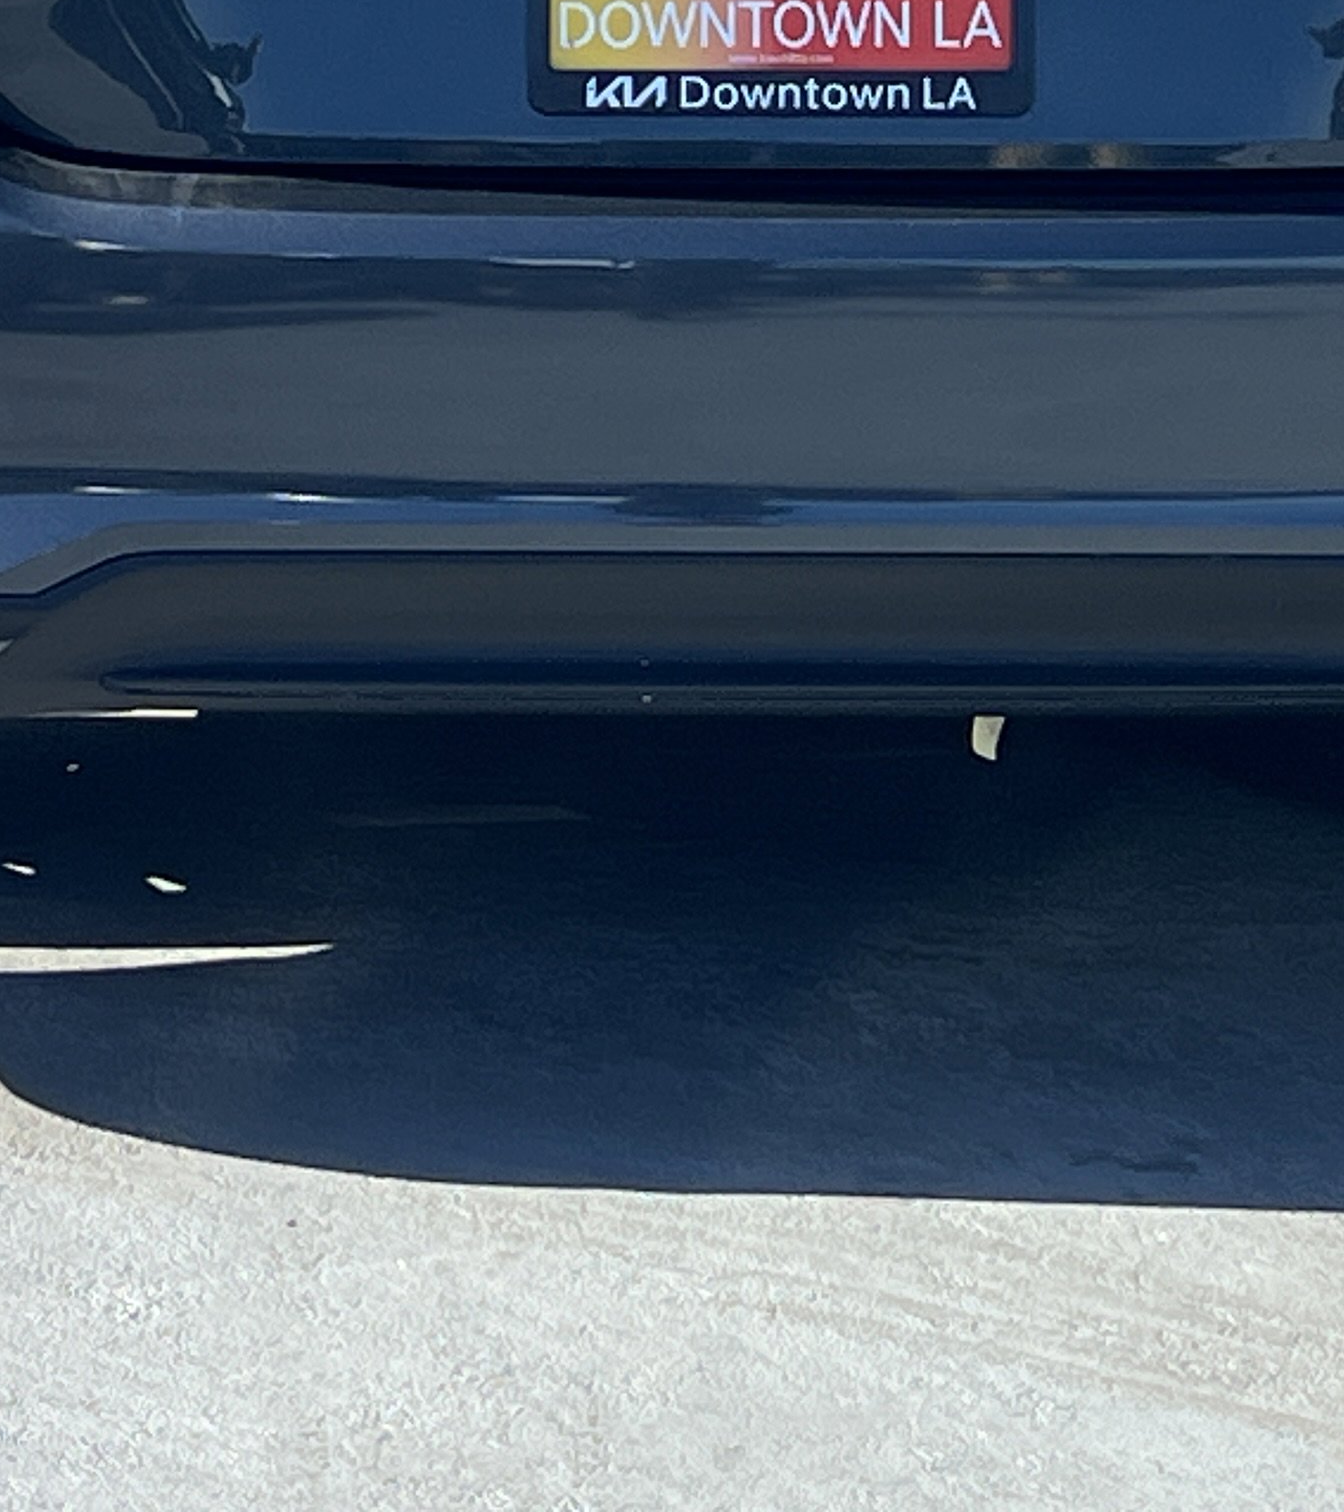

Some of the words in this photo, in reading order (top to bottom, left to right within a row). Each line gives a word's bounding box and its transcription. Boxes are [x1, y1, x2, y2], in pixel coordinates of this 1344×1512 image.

[585, 75, 667, 108] KIA
[679, 76, 910, 110] Downtown
[922, 76, 977, 110] LA
